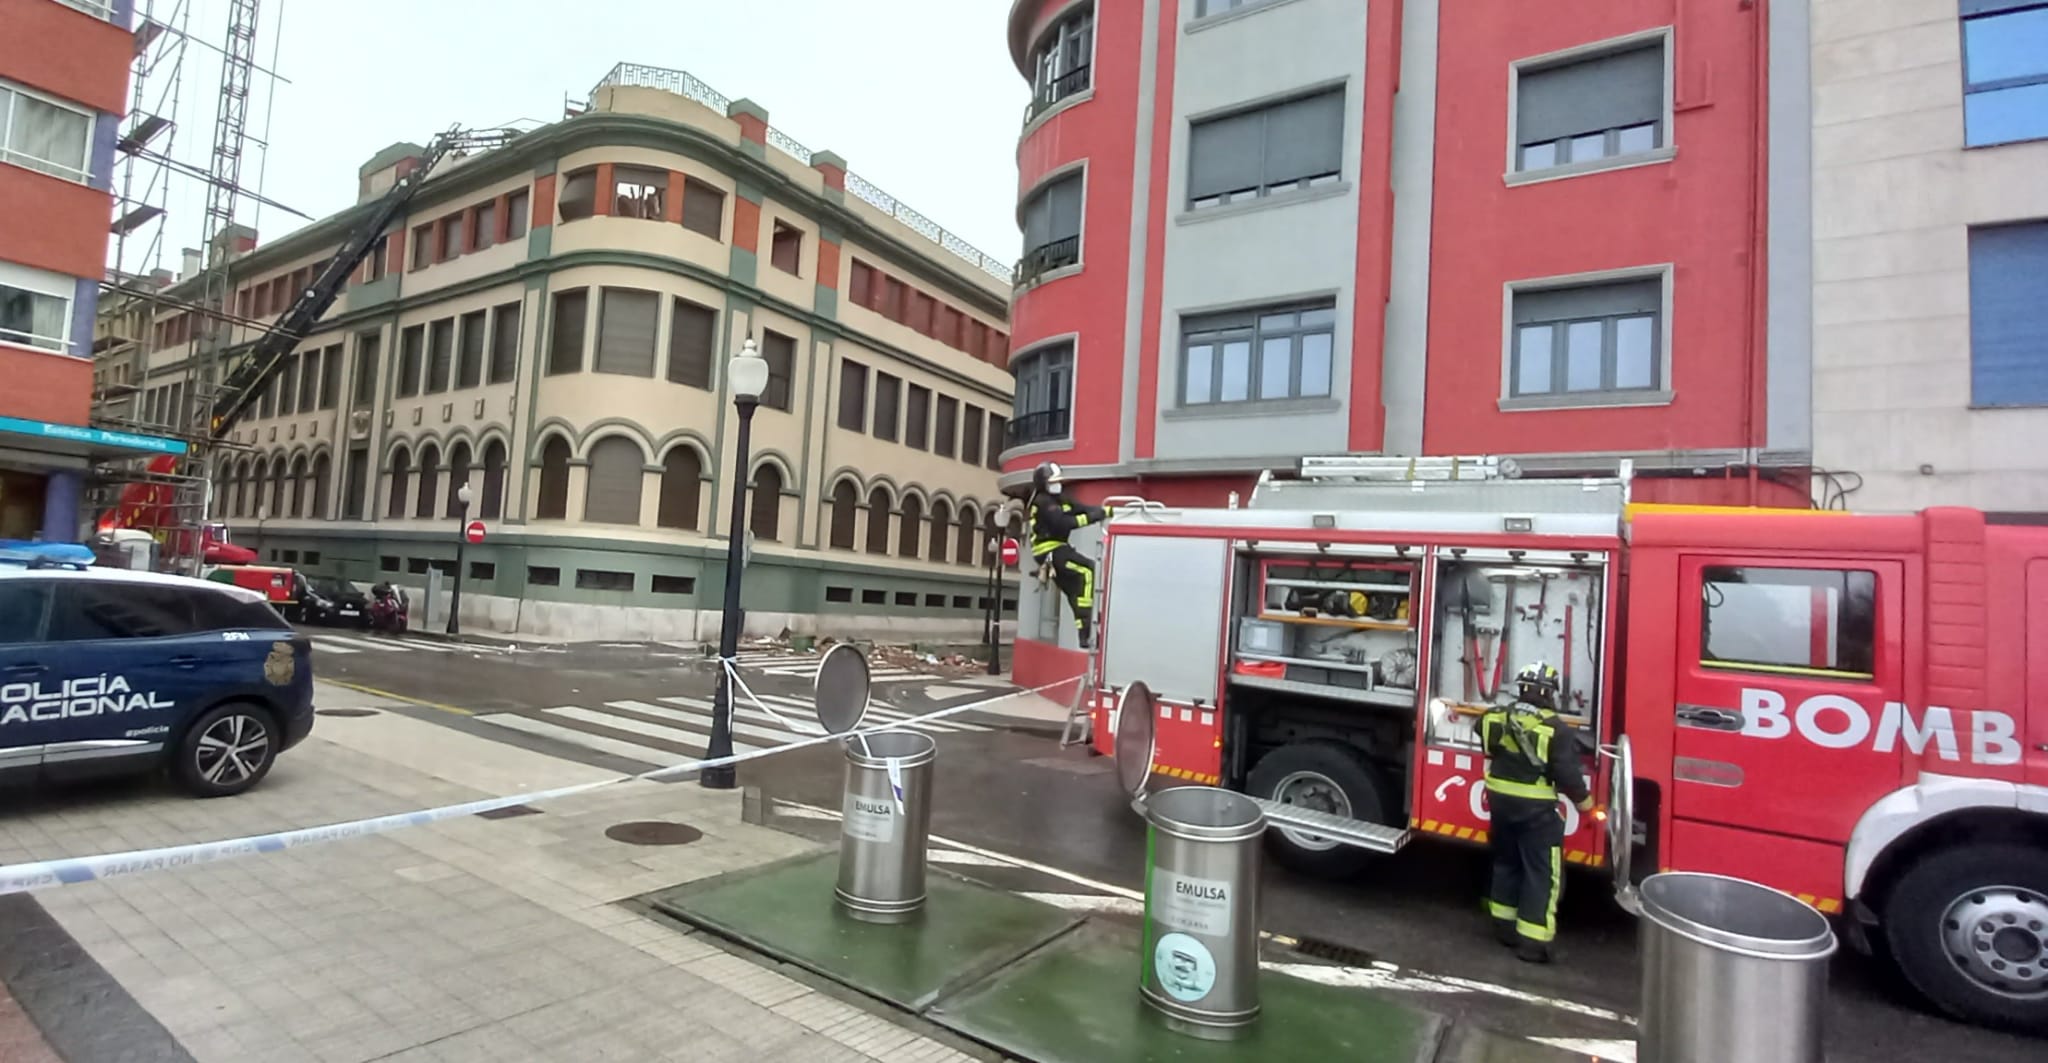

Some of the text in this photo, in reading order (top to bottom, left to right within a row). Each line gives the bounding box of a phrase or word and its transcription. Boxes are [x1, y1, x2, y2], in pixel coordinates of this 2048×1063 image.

[0, 691, 175, 725] ACIONAL
[1740, 687, 2022, 765] BOMB
[855, 800, 891, 816] EMULSA
[1176, 881, 1226, 901] EMULSA
